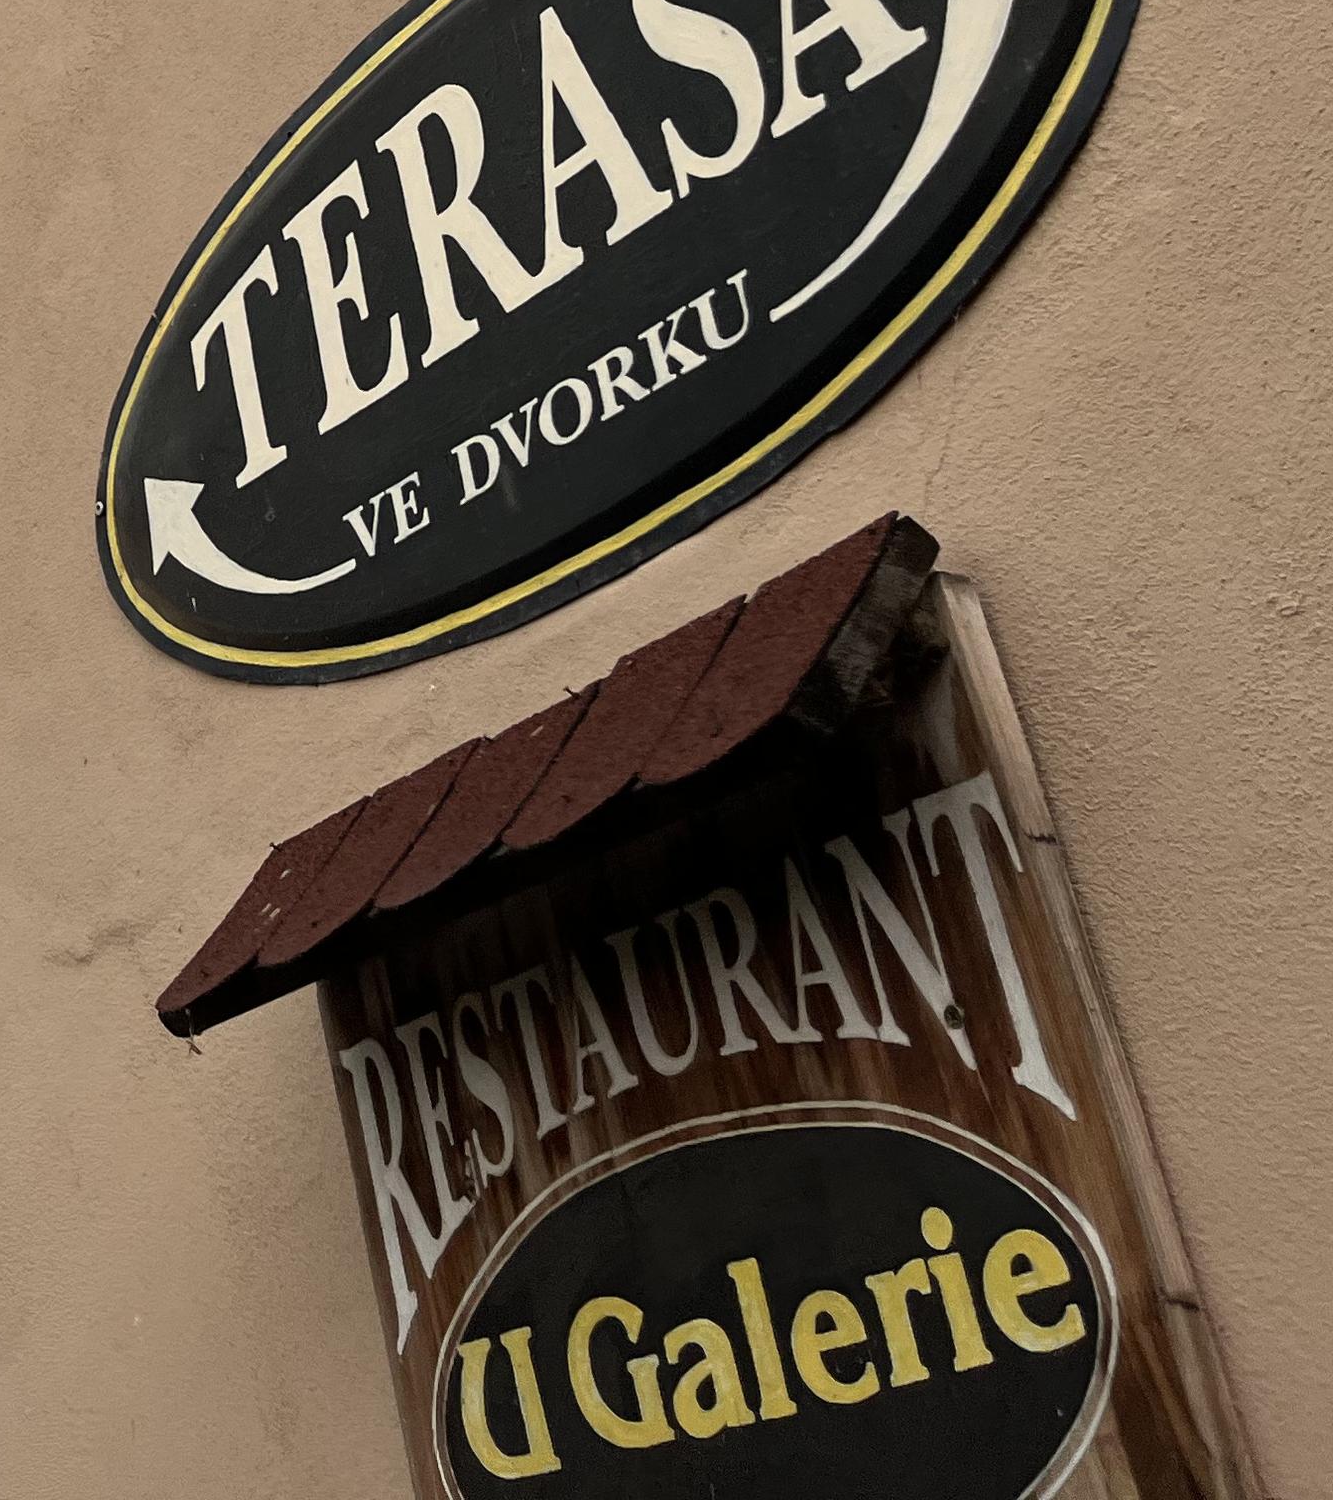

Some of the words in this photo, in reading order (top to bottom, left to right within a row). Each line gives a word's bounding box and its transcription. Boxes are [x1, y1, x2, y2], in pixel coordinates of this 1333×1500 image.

[343, 474, 430, 558] VE
[450, 270, 751, 506] DVORKU
[337, 771, 1077, 1355] RESTAURANT
[455, 1325, 562, 1480] U
[567, 1205, 1087, 1449] Galerie
